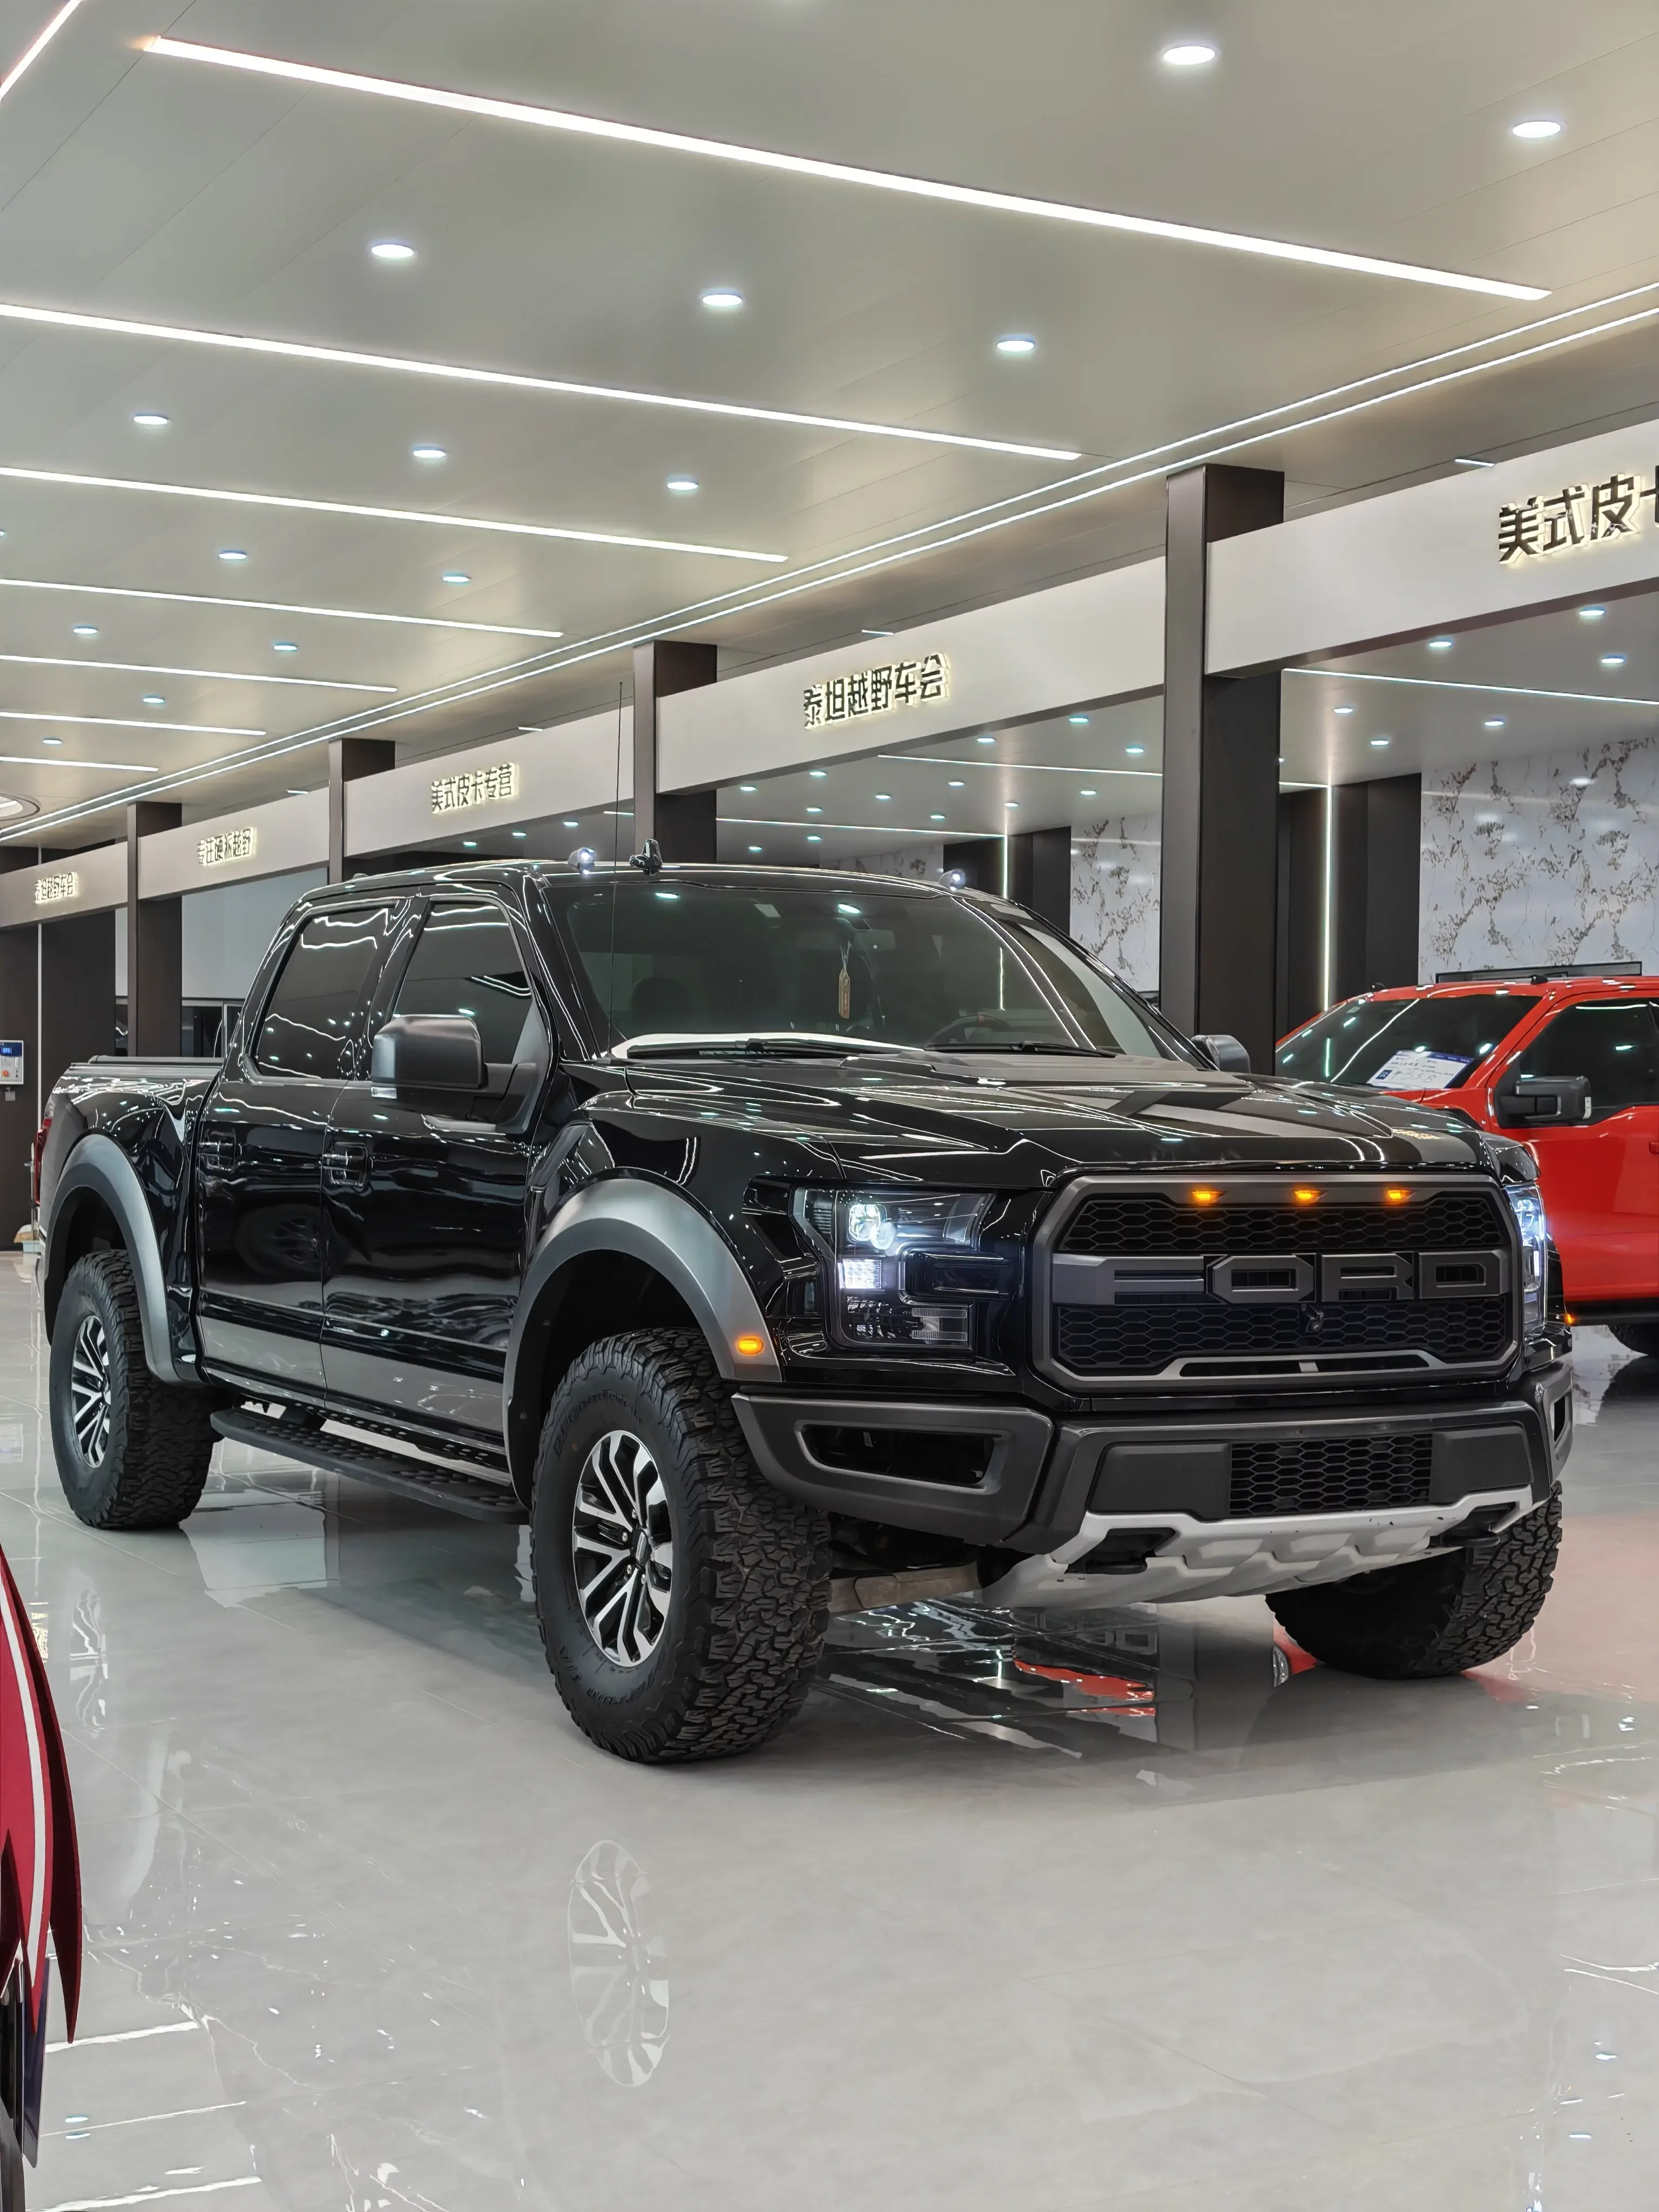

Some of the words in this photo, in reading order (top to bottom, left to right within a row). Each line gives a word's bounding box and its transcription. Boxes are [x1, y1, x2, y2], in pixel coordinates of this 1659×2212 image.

[804, 653, 946, 729] 泰坦越野车会
[431, 763, 515, 813] 美式皮卡专营
[1053, 1249, 1509, 1305] FORD
